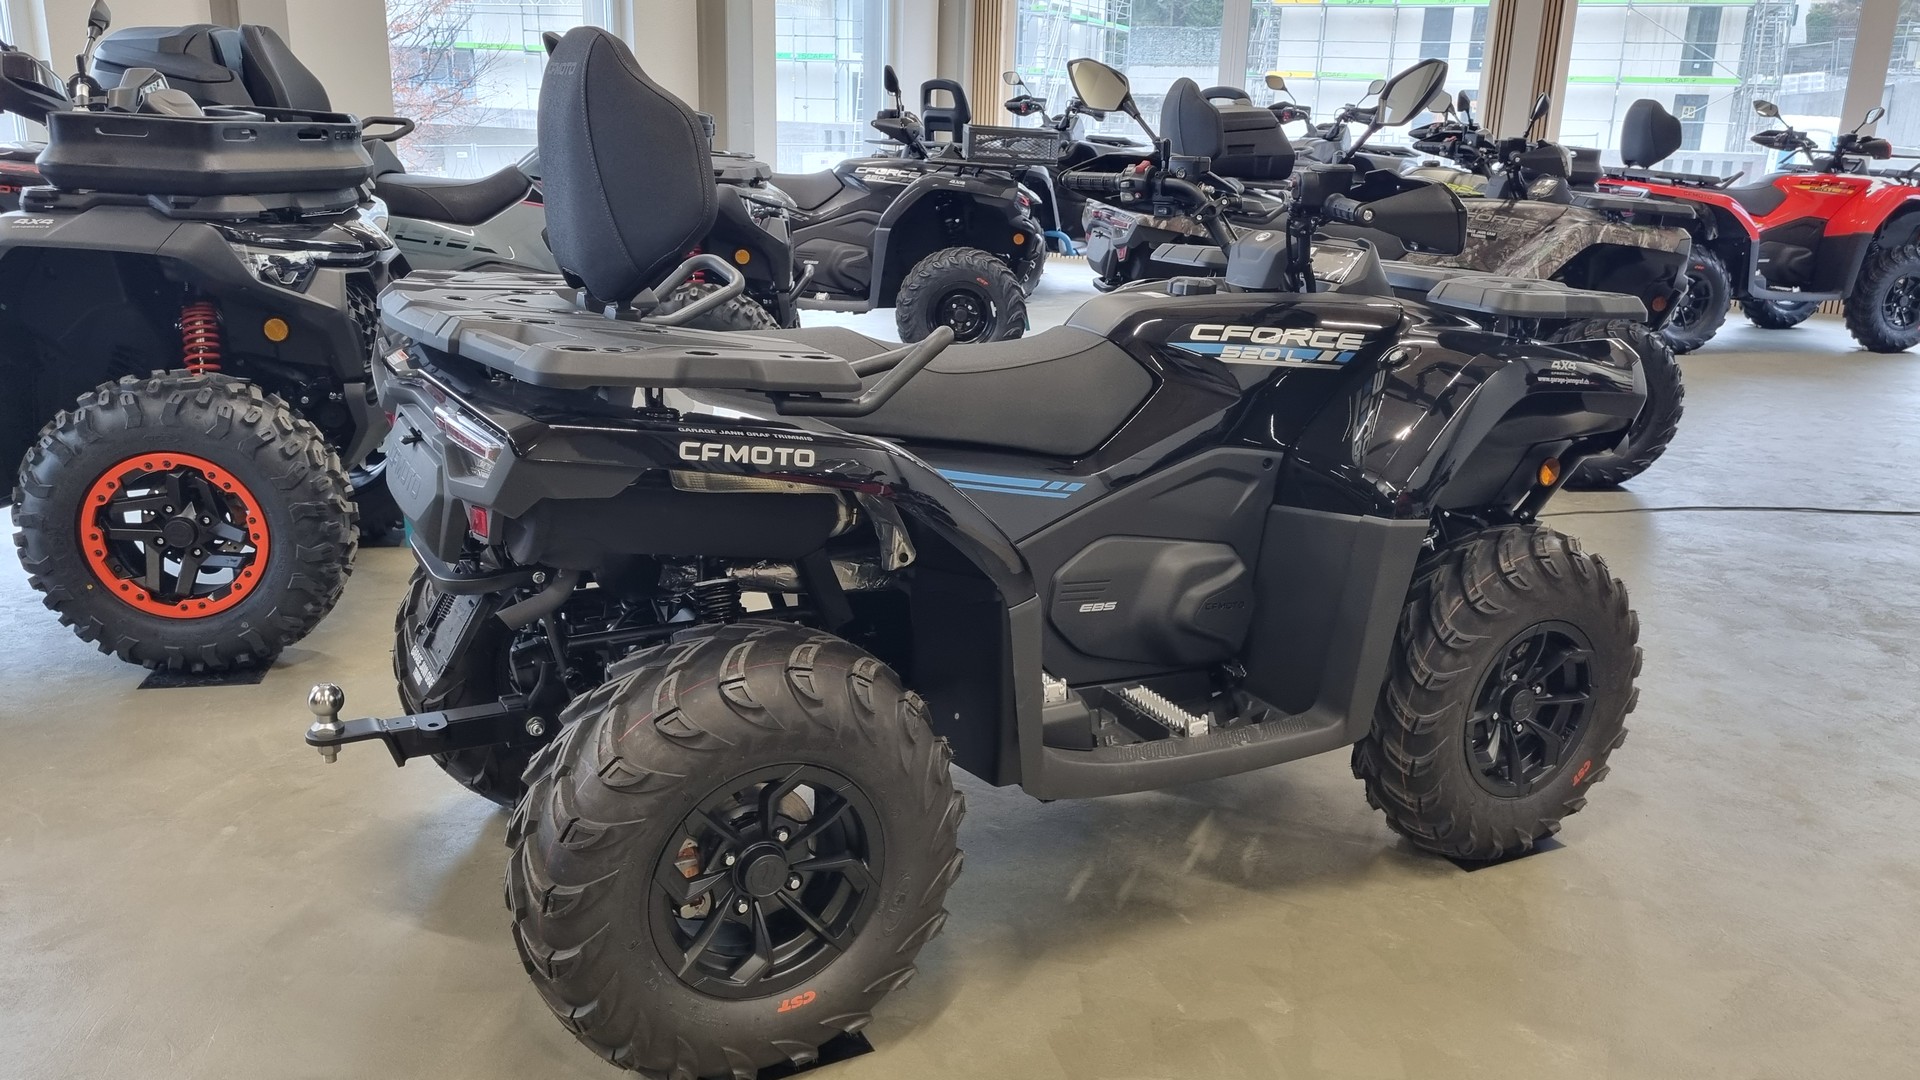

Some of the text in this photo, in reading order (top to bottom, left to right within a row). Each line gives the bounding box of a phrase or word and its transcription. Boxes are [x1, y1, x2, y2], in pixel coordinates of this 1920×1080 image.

[854, 166, 922, 179] CFORCE
[1189, 324, 1366, 350] CFORCE
[1219, 345, 1304, 363] 520 L
[678, 427, 718, 435] GARAGE
[745, 431, 771, 439] GRAF
[772, 433, 814, 442] TRIMMIS
[679, 441, 816, 468] CFMOTO
[1079, 601, 1118, 613] EBS
[1572, 760, 1592, 787] CST
[777, 990, 816, 1013] CST
